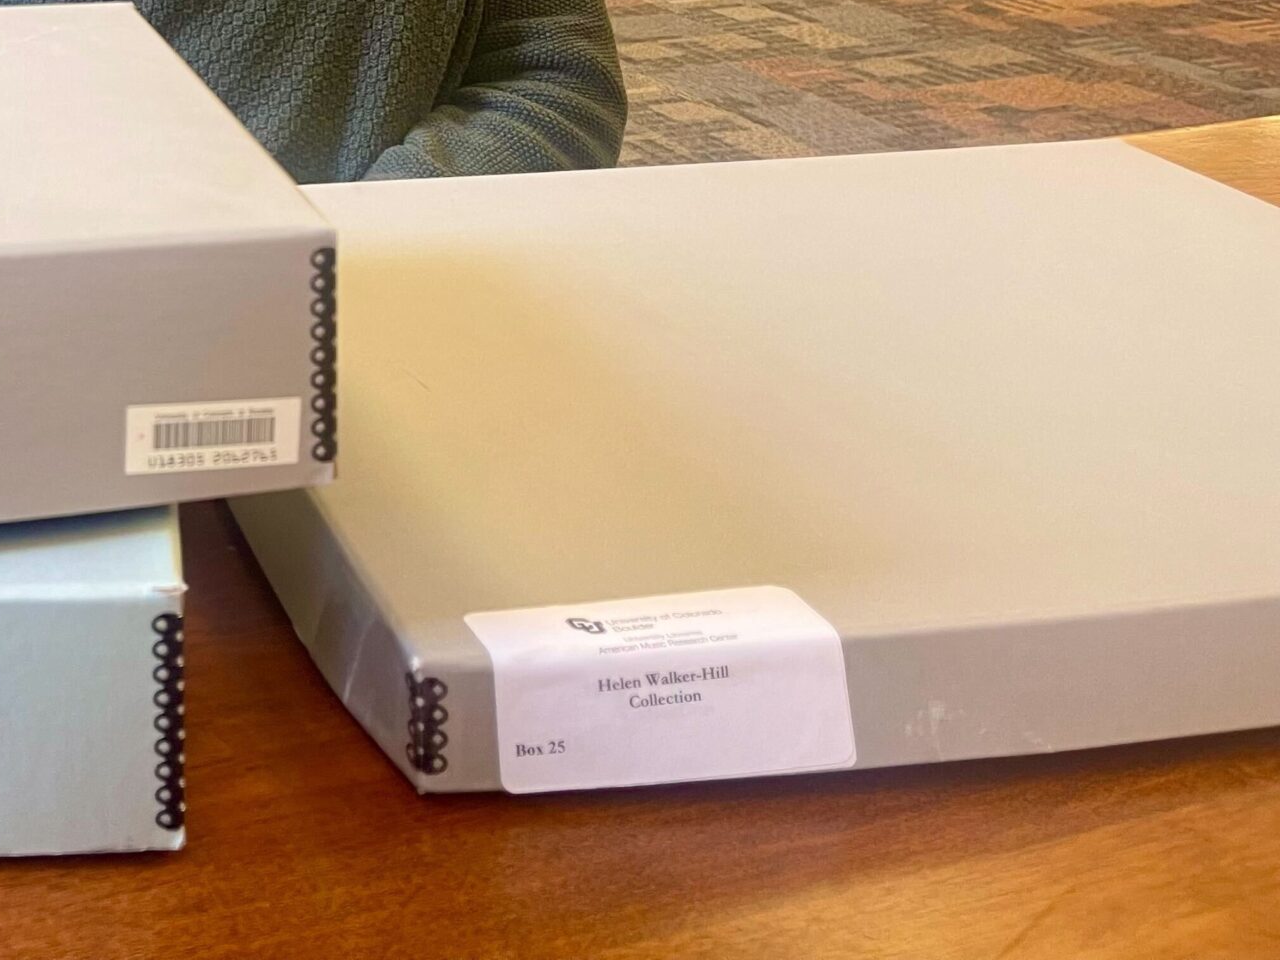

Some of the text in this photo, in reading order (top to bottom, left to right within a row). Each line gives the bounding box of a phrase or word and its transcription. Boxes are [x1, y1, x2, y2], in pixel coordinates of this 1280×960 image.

[605, 609, 723, 627] University of Colorado
[613, 623, 654, 633] Boulder
[599, 633, 738, 655] American Music Research Center
[597, 664, 730, 693] Helen Walker-Hill
[628, 690, 702, 709] Collection
[516, 740, 566, 757] Box 25
